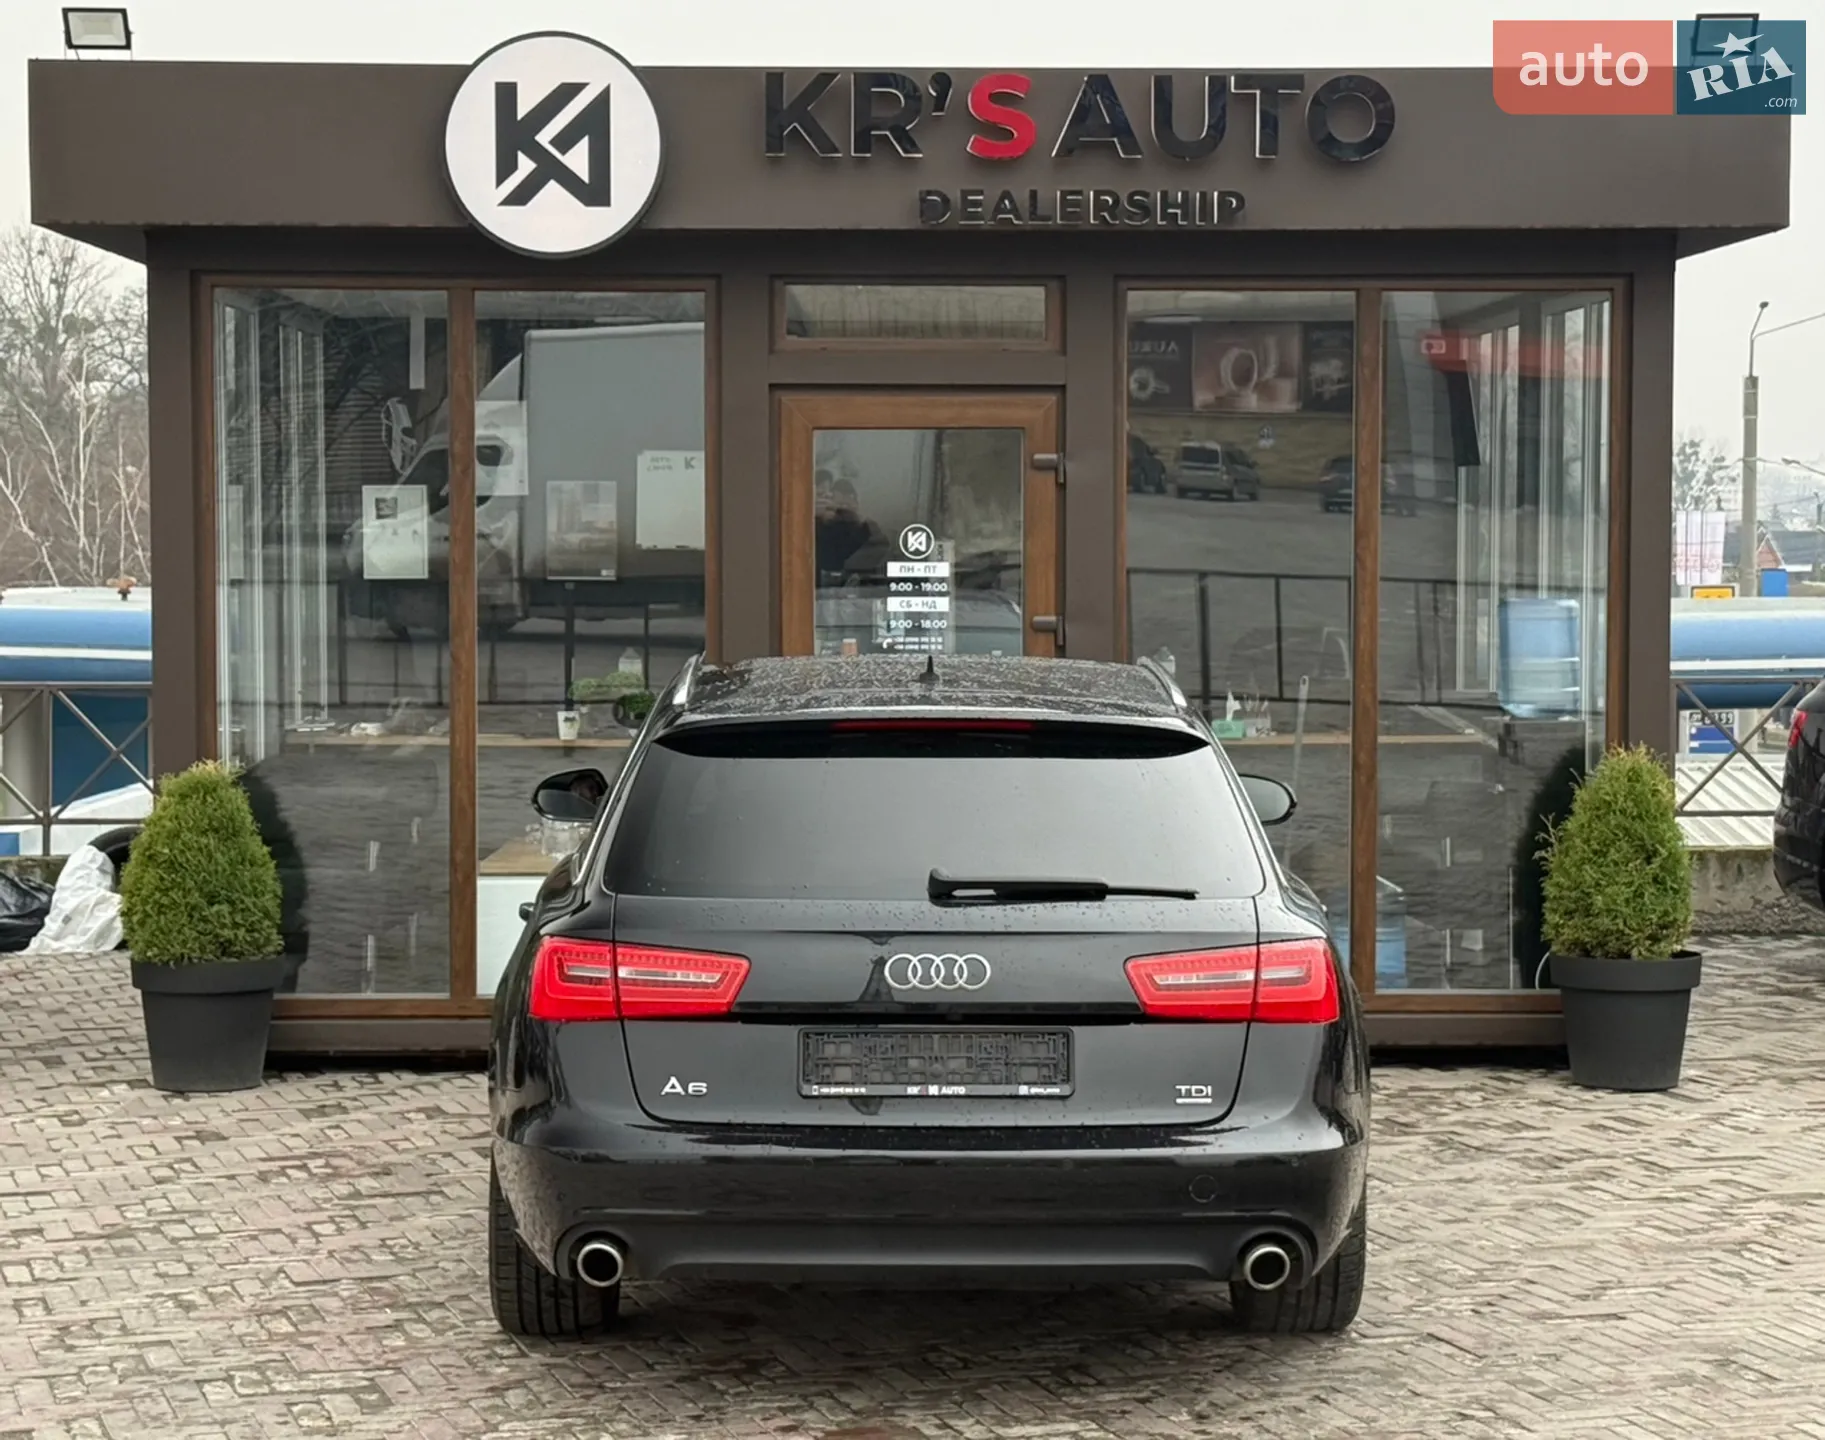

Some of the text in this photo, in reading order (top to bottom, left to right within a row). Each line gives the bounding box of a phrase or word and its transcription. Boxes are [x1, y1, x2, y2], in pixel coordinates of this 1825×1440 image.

[1051, 73, 1395, 161] AUTO
[919, 189, 1246, 225] DEALERSHIP
[899, 566, 915, 574] ПН
[923, 566, 937, 574] ПТ
[899, 600, 912, 609] СБ
[921, 600, 937, 610] НД
[660, 1076, 708, 1096] A6
[940, 1086, 966, 1095] AUTO
[1175, 1085, 1212, 1097] TDI
